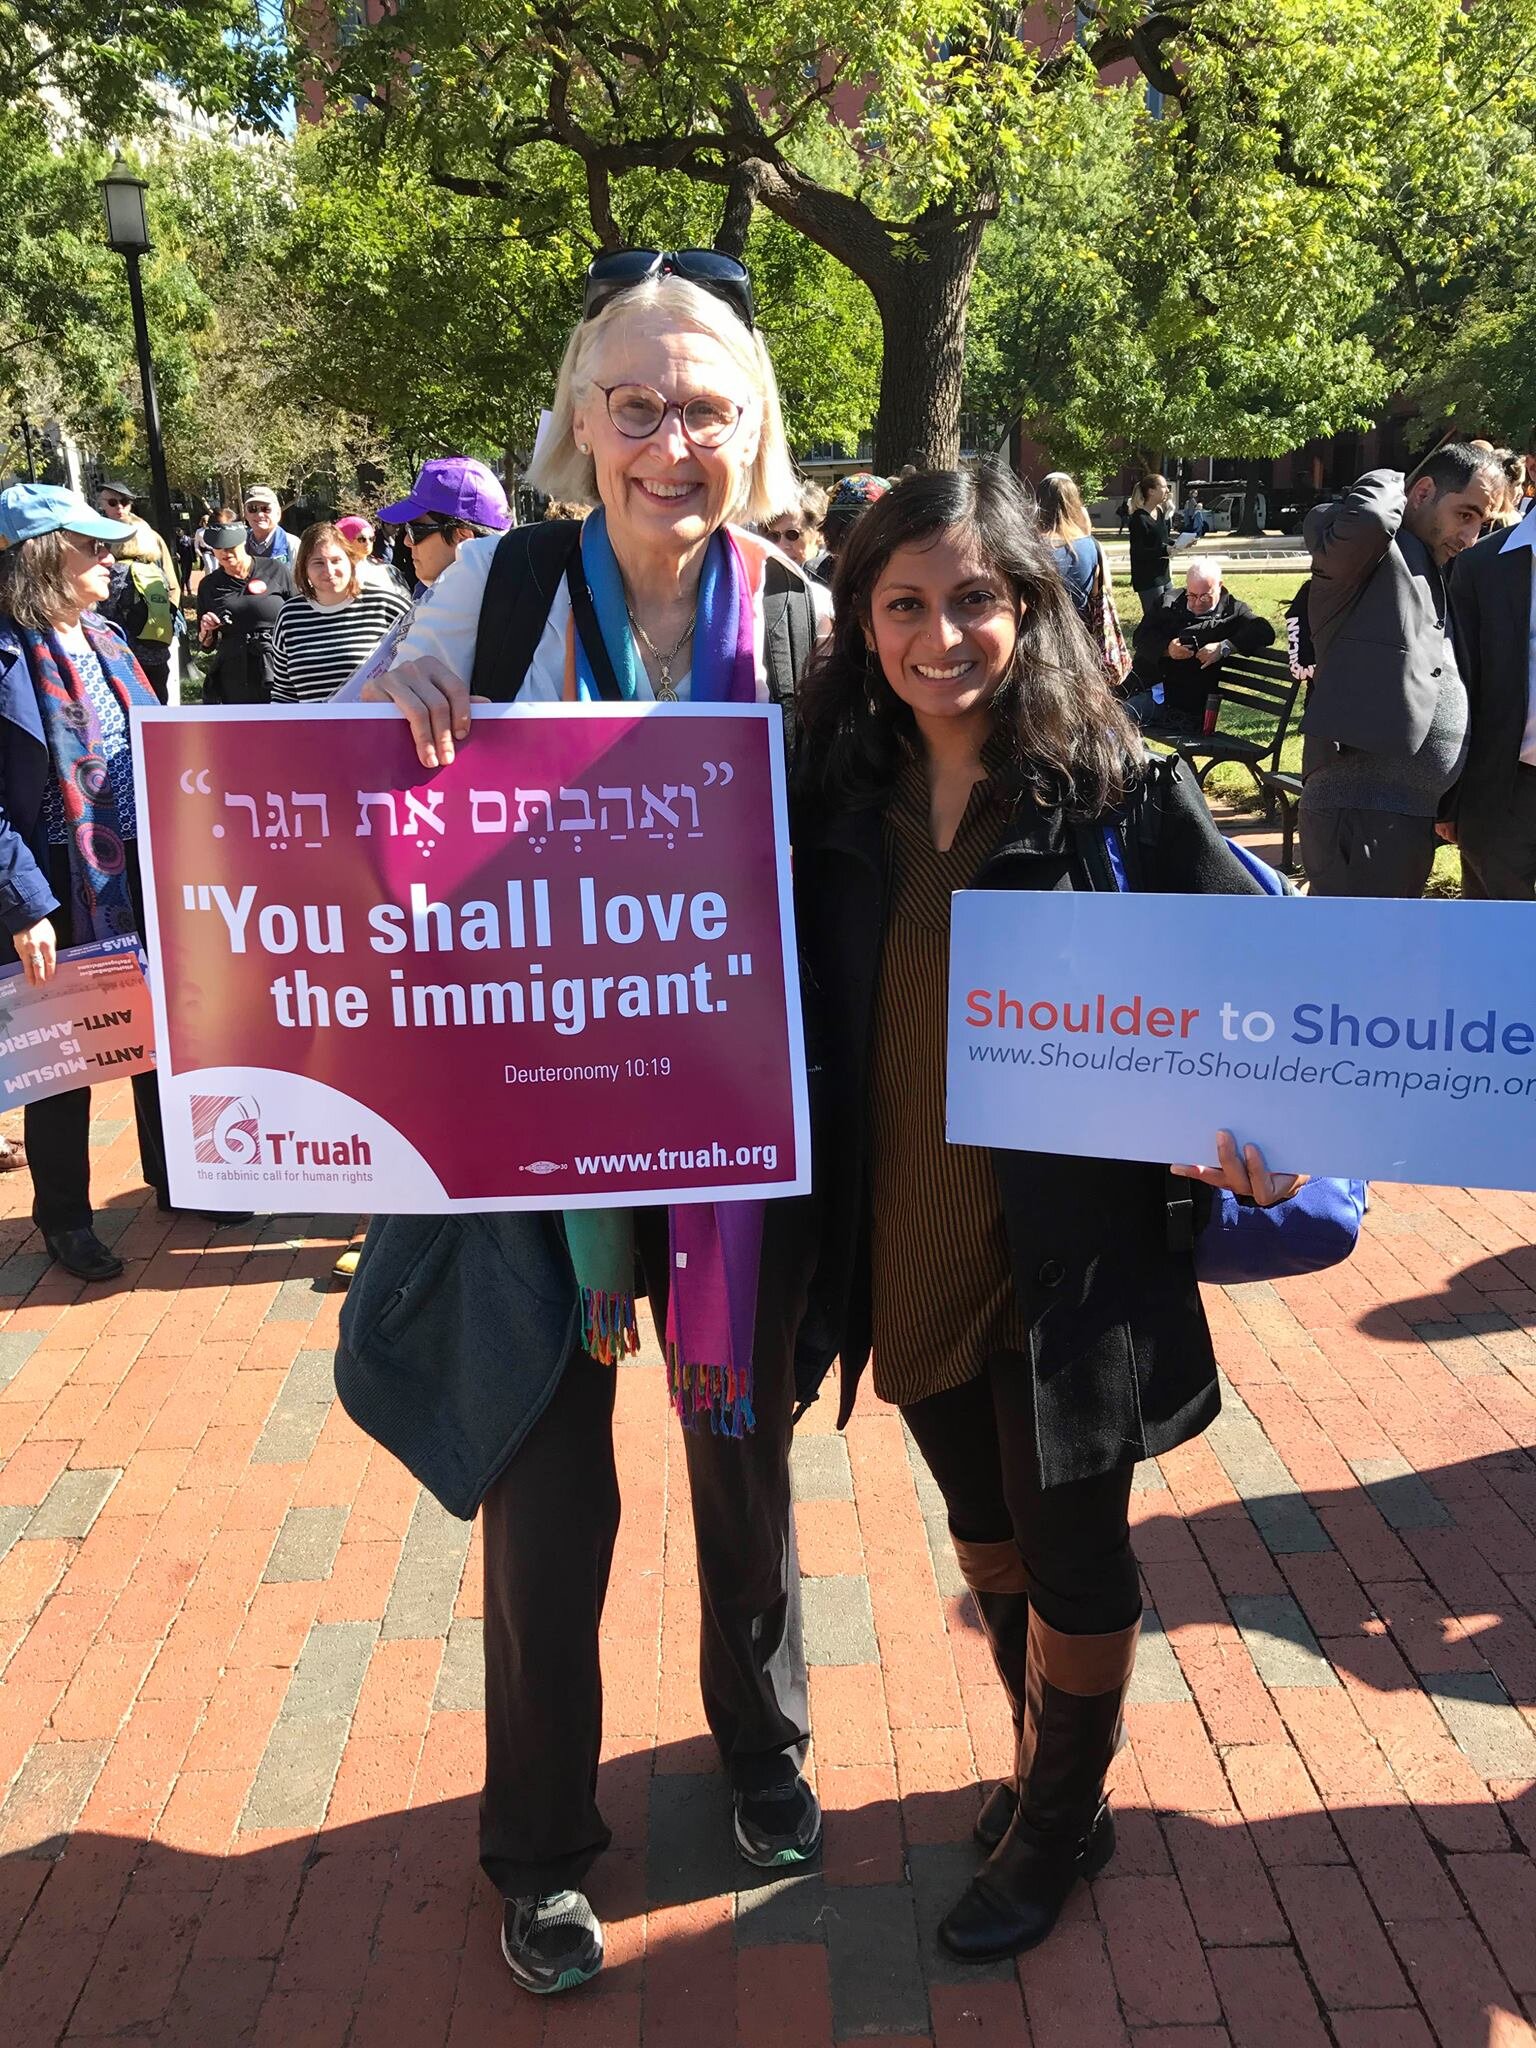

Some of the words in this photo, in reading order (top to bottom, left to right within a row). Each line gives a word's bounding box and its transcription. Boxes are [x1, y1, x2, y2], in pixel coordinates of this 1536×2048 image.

[182, 884, 345, 954] "You
[367, 879, 552, 954] shall
[579, 877, 728, 944] love
[102, 935, 138, 952] HIAS
[270, 969, 369, 1028] the
[390, 953, 752, 1035] immigrant."
[965, 988, 1200, 1039] Shoulder
[1219, 1002, 1275, 1043] to
[1290, 1003, 1535, 1056] Shoulde
[59, 1038, 81, 1056] IS
[4, 1045, 144, 1094] ANTI-MUSLIM
[505, 1063, 619, 1083] Deuteronomy
[624, 1057, 671, 1077] 10:19
[968, 1042, 1536, 1100] www.ShoulderToShoulderCampaign.or
[265, 1131, 372, 1166] T'ruah
[574, 1142, 778, 1175] www.truah.org
[197, 1170, 213, 1180] the
[216, 1170, 259, 1181] rabbinic
[262, 1170, 281, 1181] call
[284, 1170, 300, 1181] for
[302, 1170, 339, 1181] human
[342, 1171, 373, 1184] rights
